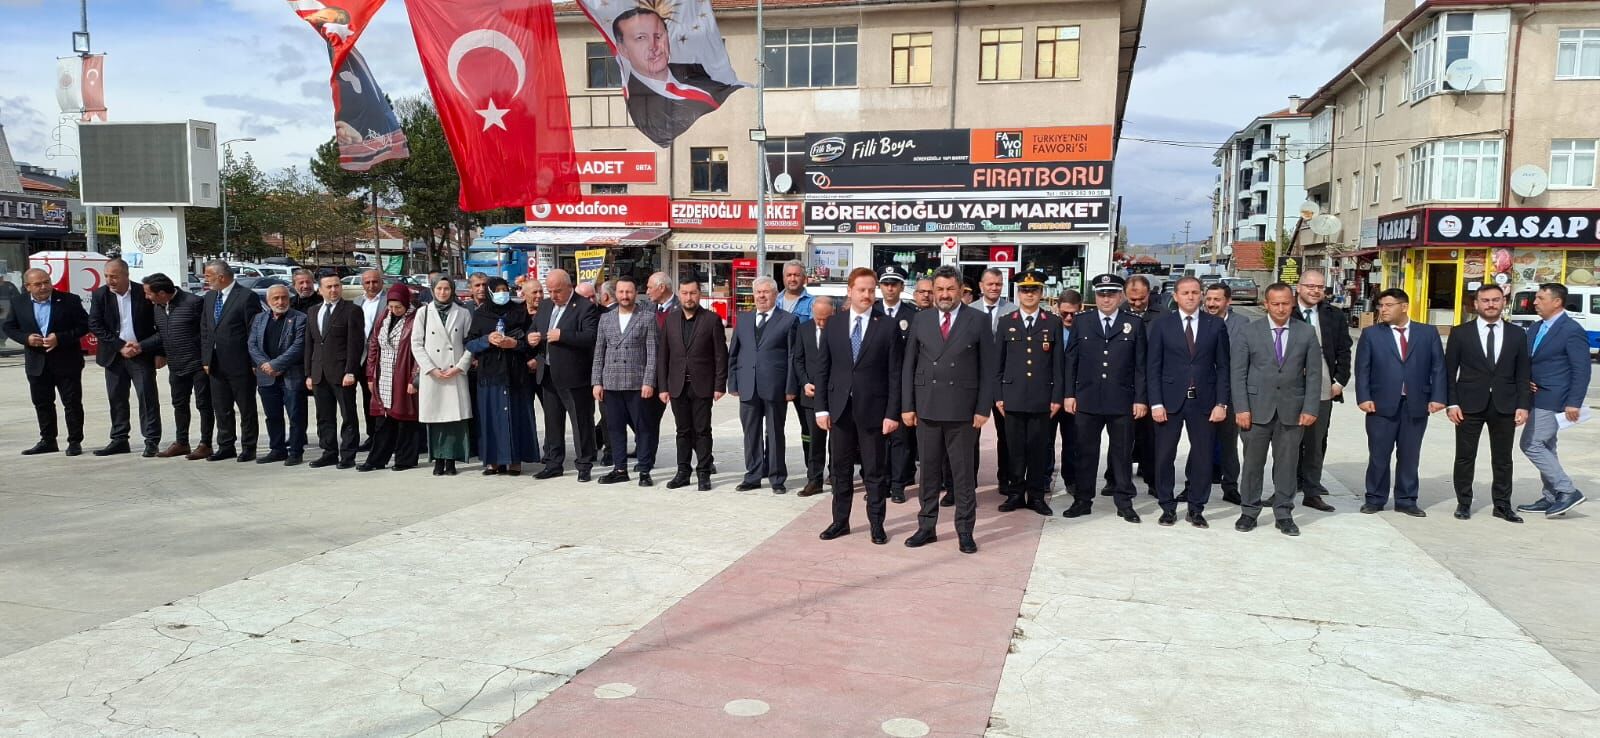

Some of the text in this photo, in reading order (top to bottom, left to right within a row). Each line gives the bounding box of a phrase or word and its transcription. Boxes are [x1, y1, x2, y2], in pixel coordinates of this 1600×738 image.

[852, 136, 916, 160] Filli Boya
[560, 160, 625, 175] SAADET
[973, 165, 1104, 188] FIRATBORU
[555, 201, 628, 215] vodafone
[671, 201, 799, 219] EZDEROĞLU MRKET
[811, 200, 1103, 220] BÖREKCİOĞLU YAPI MARKET
[1382, 217, 1411, 241] KASAP
[1469, 215, 1590, 238] KASAP
[678, 242, 743, 250] EZDEROĞLU
